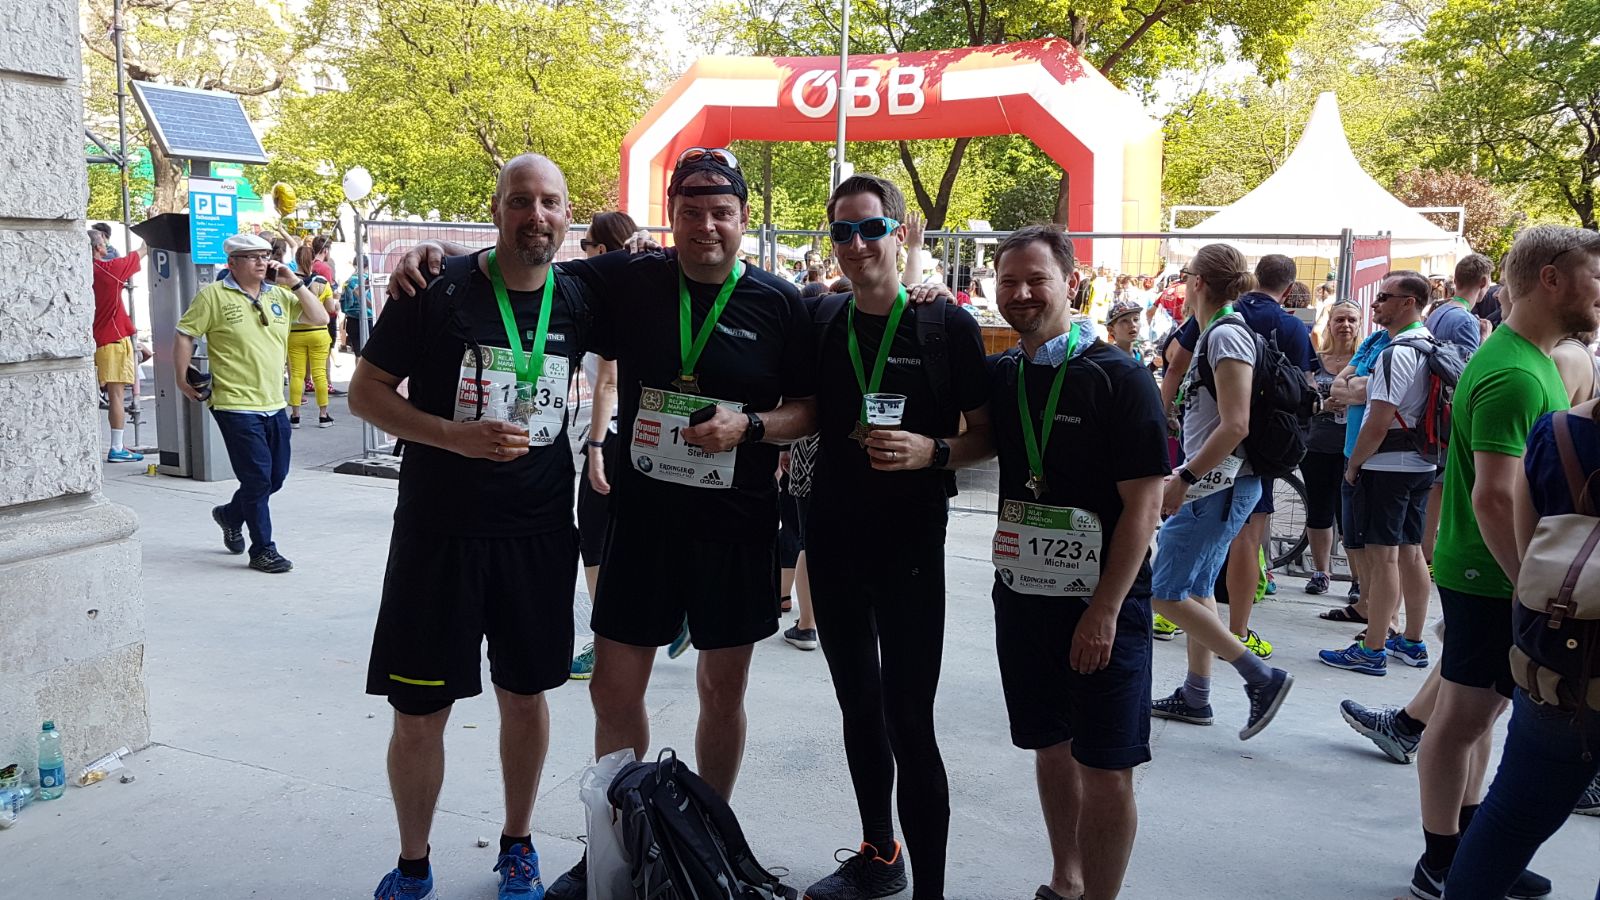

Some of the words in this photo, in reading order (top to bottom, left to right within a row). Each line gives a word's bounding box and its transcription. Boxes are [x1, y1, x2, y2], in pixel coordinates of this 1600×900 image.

[791, 66, 925, 118] ÖBB
[198, 198, 208, 210] P
[157, 252, 167, 273] P
[554, 397, 564, 408] B
[636, 420, 660, 433] Kronen
[636, 430, 659, 444] Zeitung
[688, 449, 714, 459] Stefan
[659, 463, 688, 474] ERDINGER
[1224, 477, 1232, 485] A
[1028, 538, 1083, 560] 1723
[1085, 550, 1097, 563] A
[1044, 558, 1080, 569] Michael
[1020, 575, 1048, 584] ERDINGER
